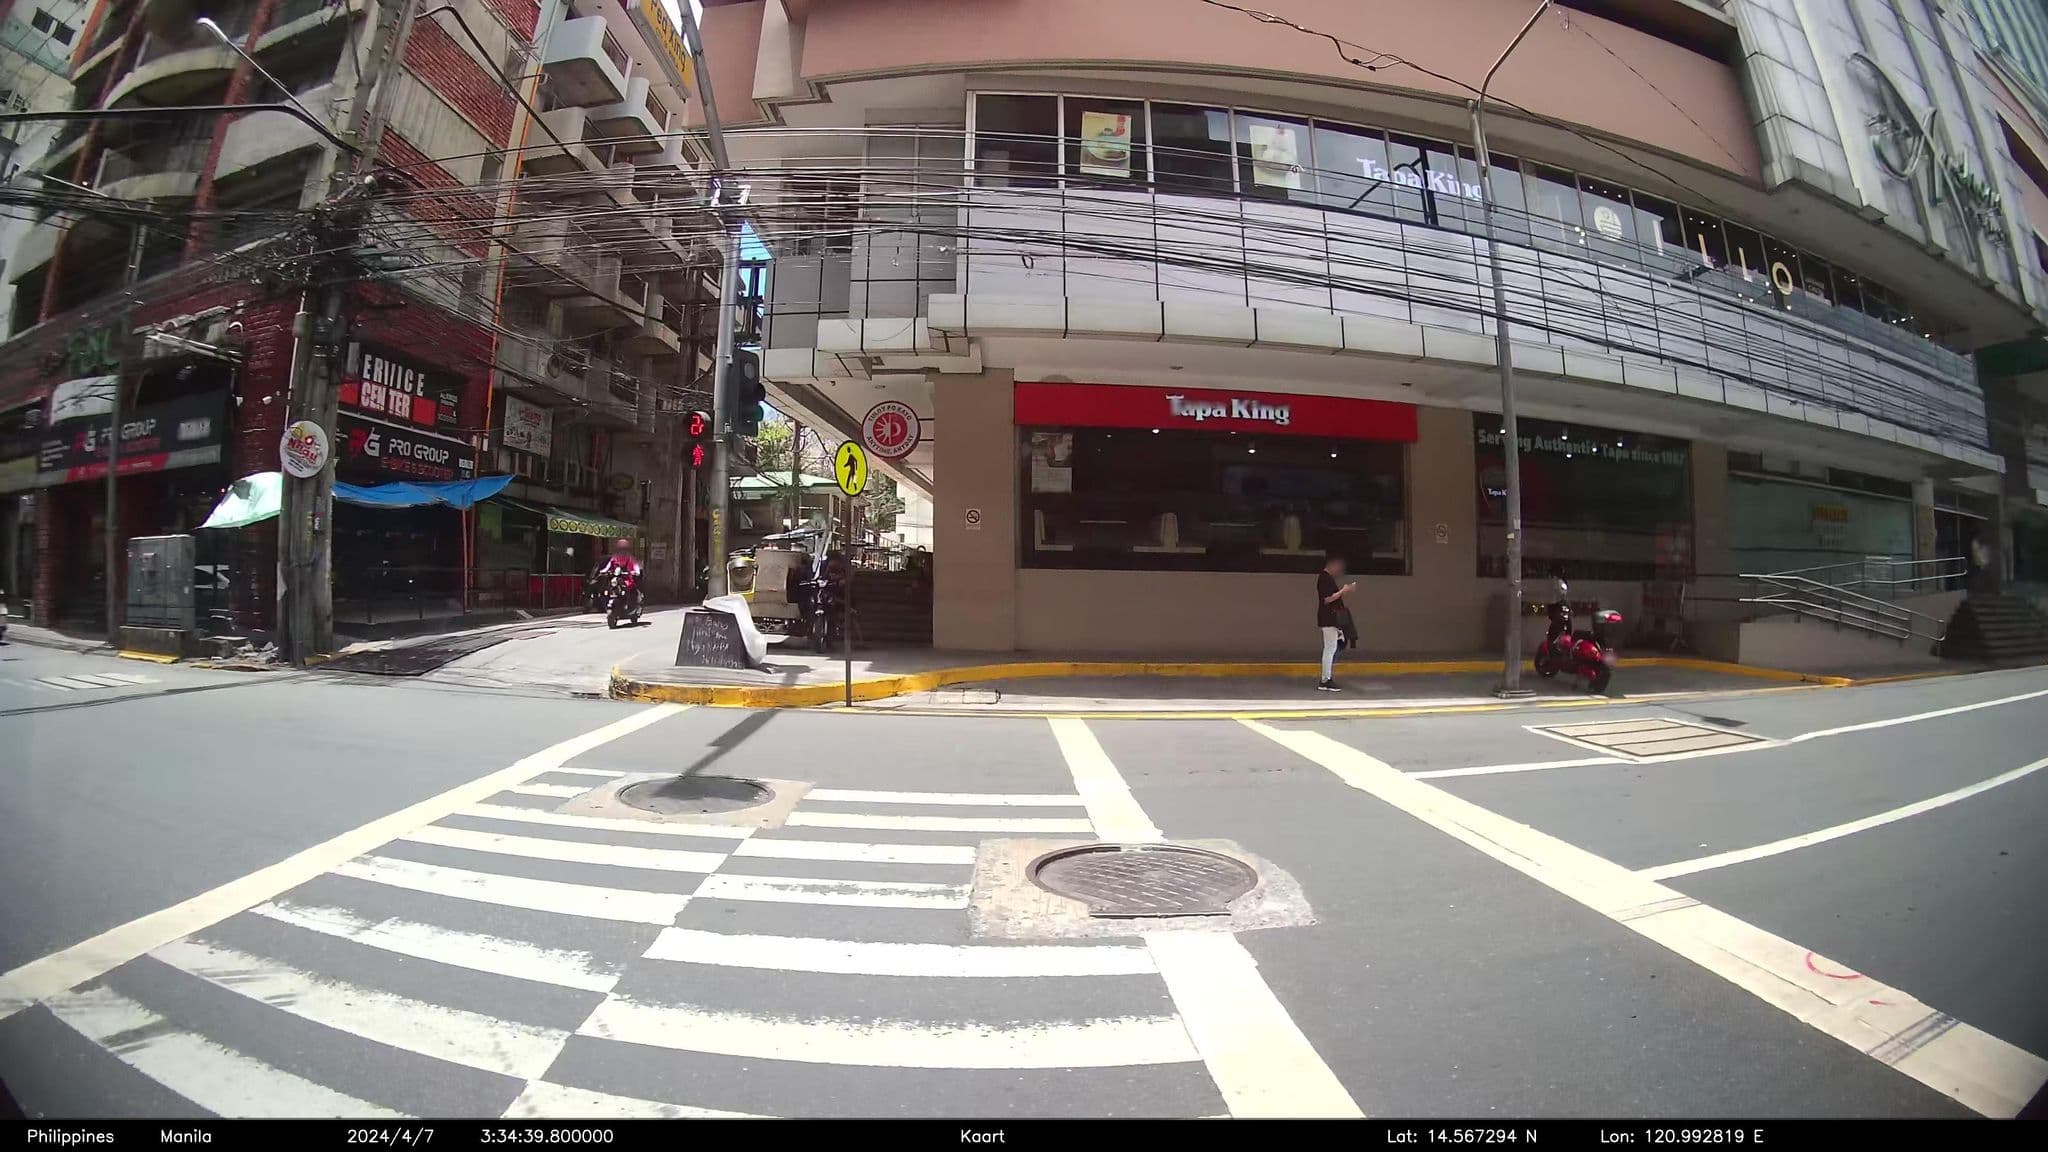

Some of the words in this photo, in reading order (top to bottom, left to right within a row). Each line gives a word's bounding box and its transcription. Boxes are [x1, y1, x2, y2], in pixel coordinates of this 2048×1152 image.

[1165, 394, 1227, 421] Tapa
[1230, 398, 1290, 426] King
[389, 438, 412, 457] PRO
[413, 444, 450, 465] GROUP
